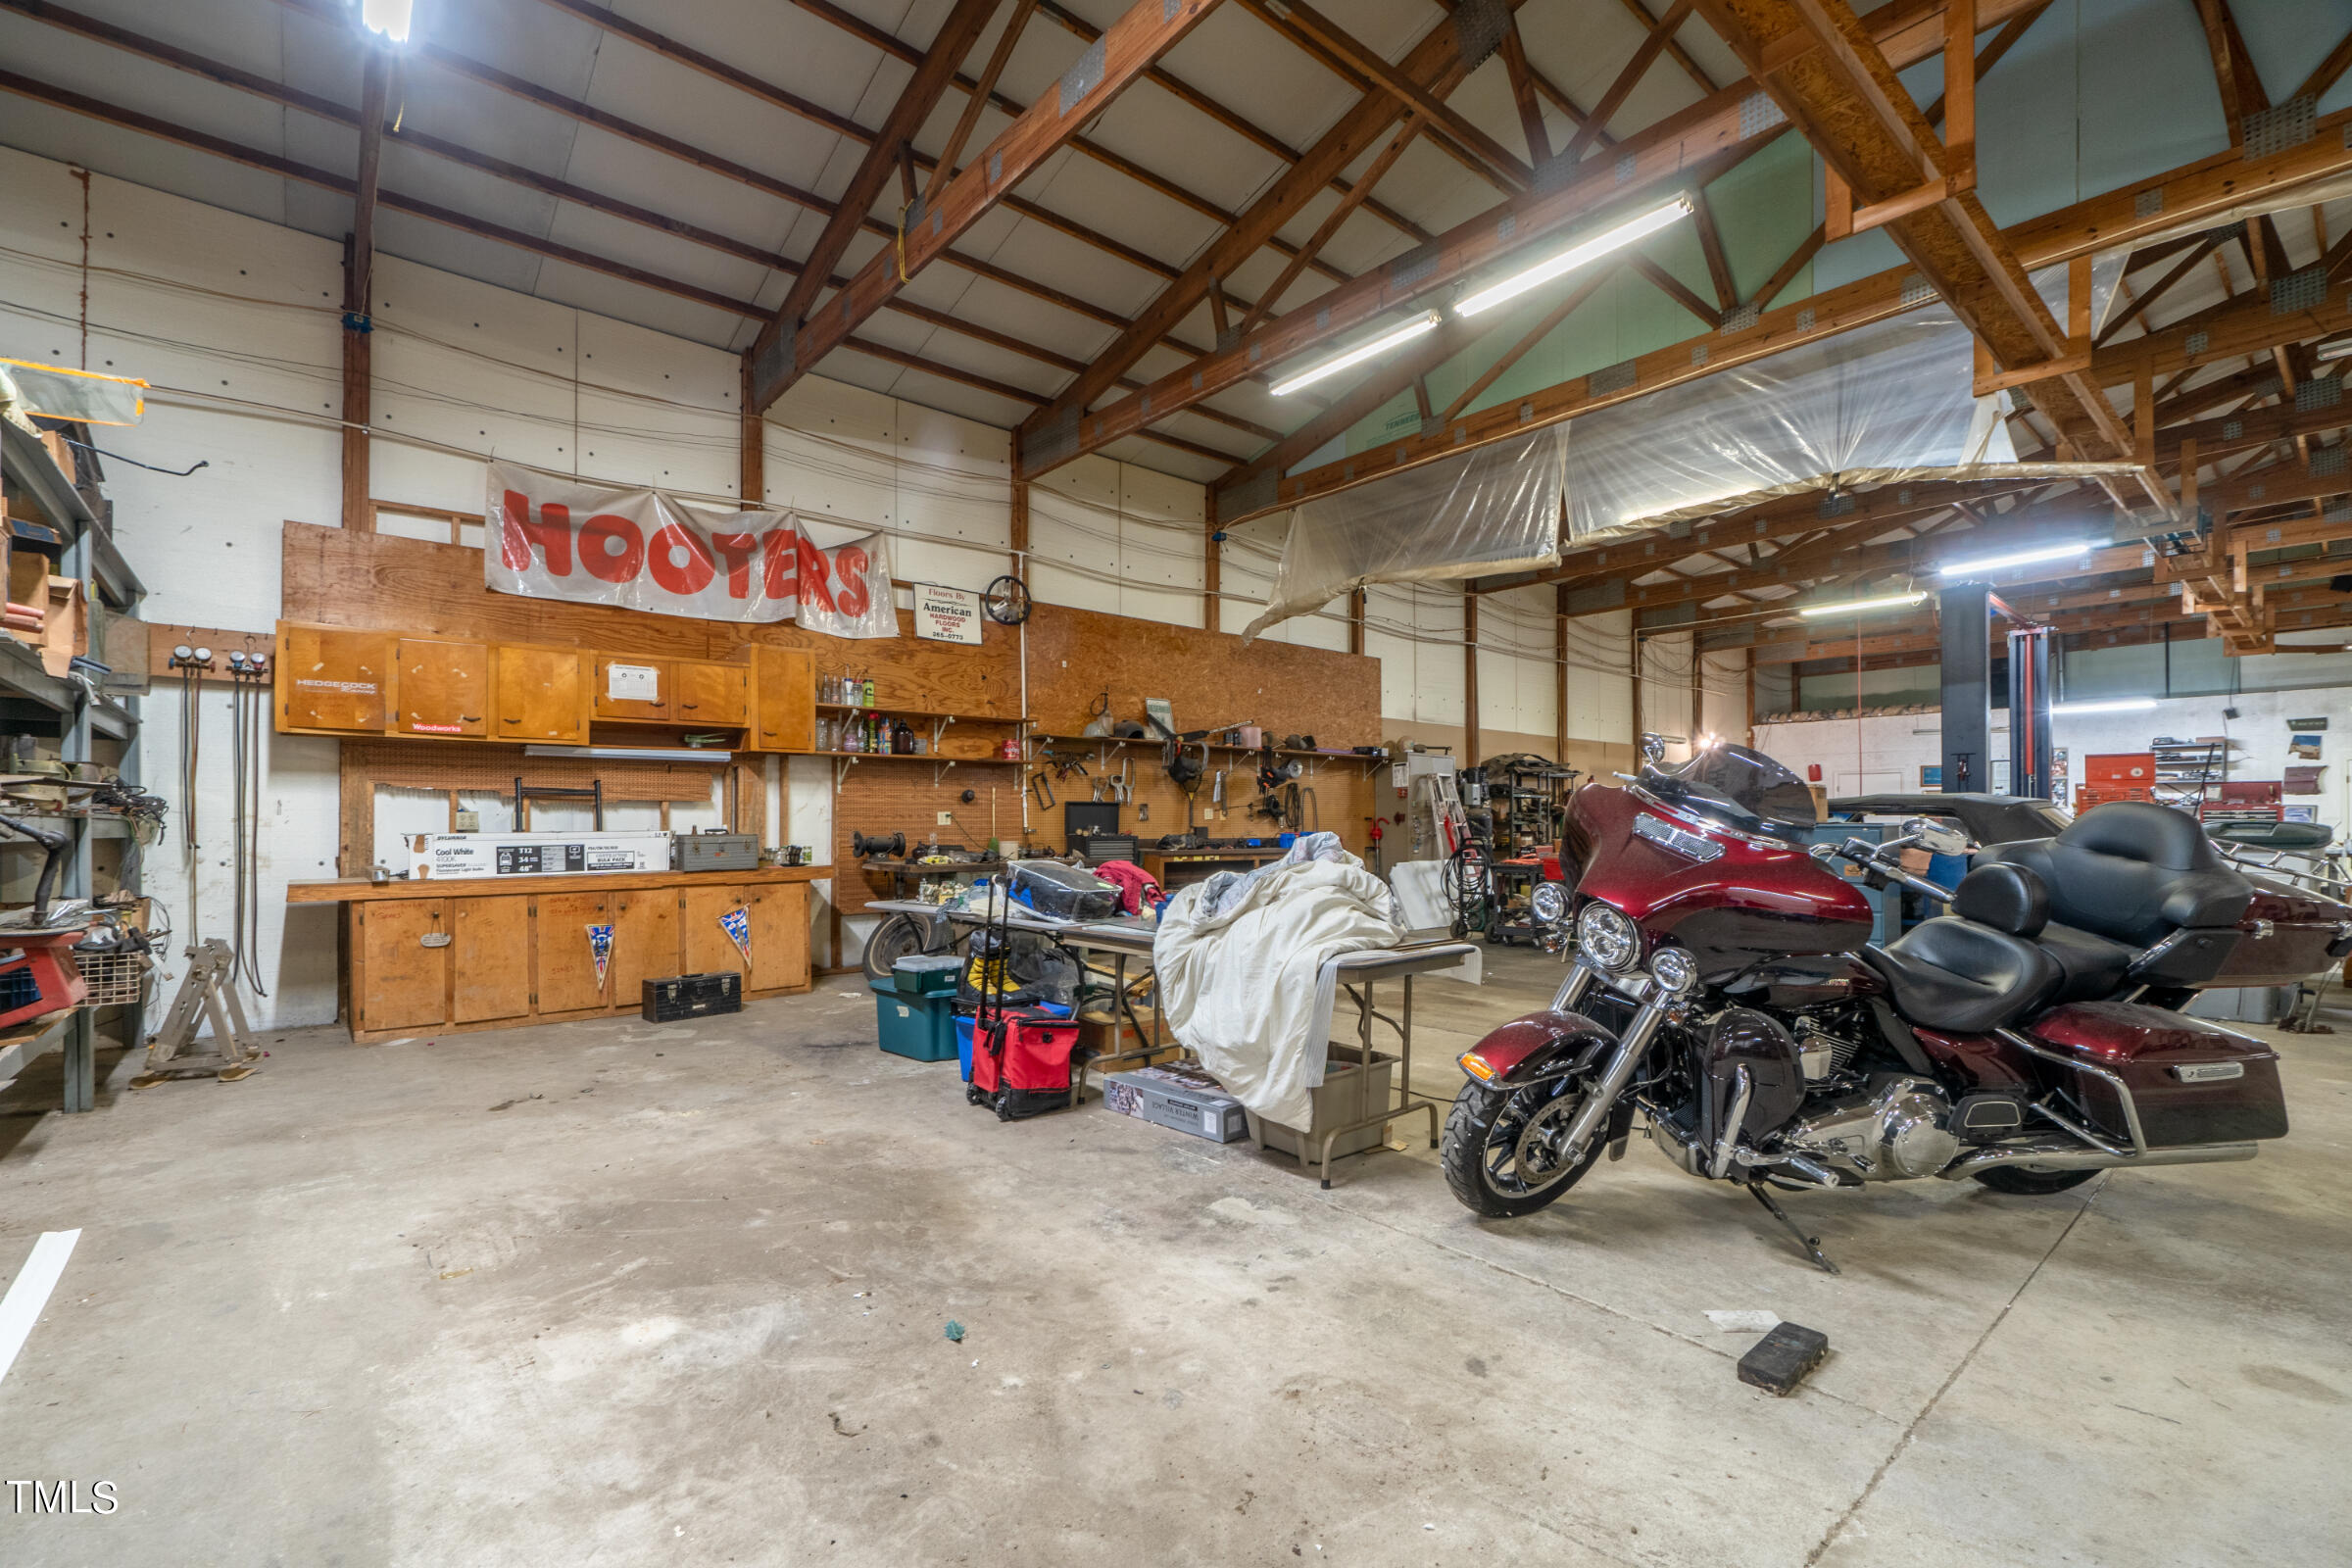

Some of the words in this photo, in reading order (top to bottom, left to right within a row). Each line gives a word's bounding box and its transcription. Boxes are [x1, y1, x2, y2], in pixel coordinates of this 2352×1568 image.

[502, 489, 870, 617] HOOTERS
[929, 588, 953, 599] Floors
[956, 592, 965, 601] By
[923, 603, 971, 616] American
[930, 612, 965, 622] HARDWOOD
[297, 679, 376, 690] HEDGECOCK
[413, 722, 462, 732] Woodworks
[1152, 1101, 1174, 1114] VILLAGE
[1176, 1107, 1199, 1121] WINTER
